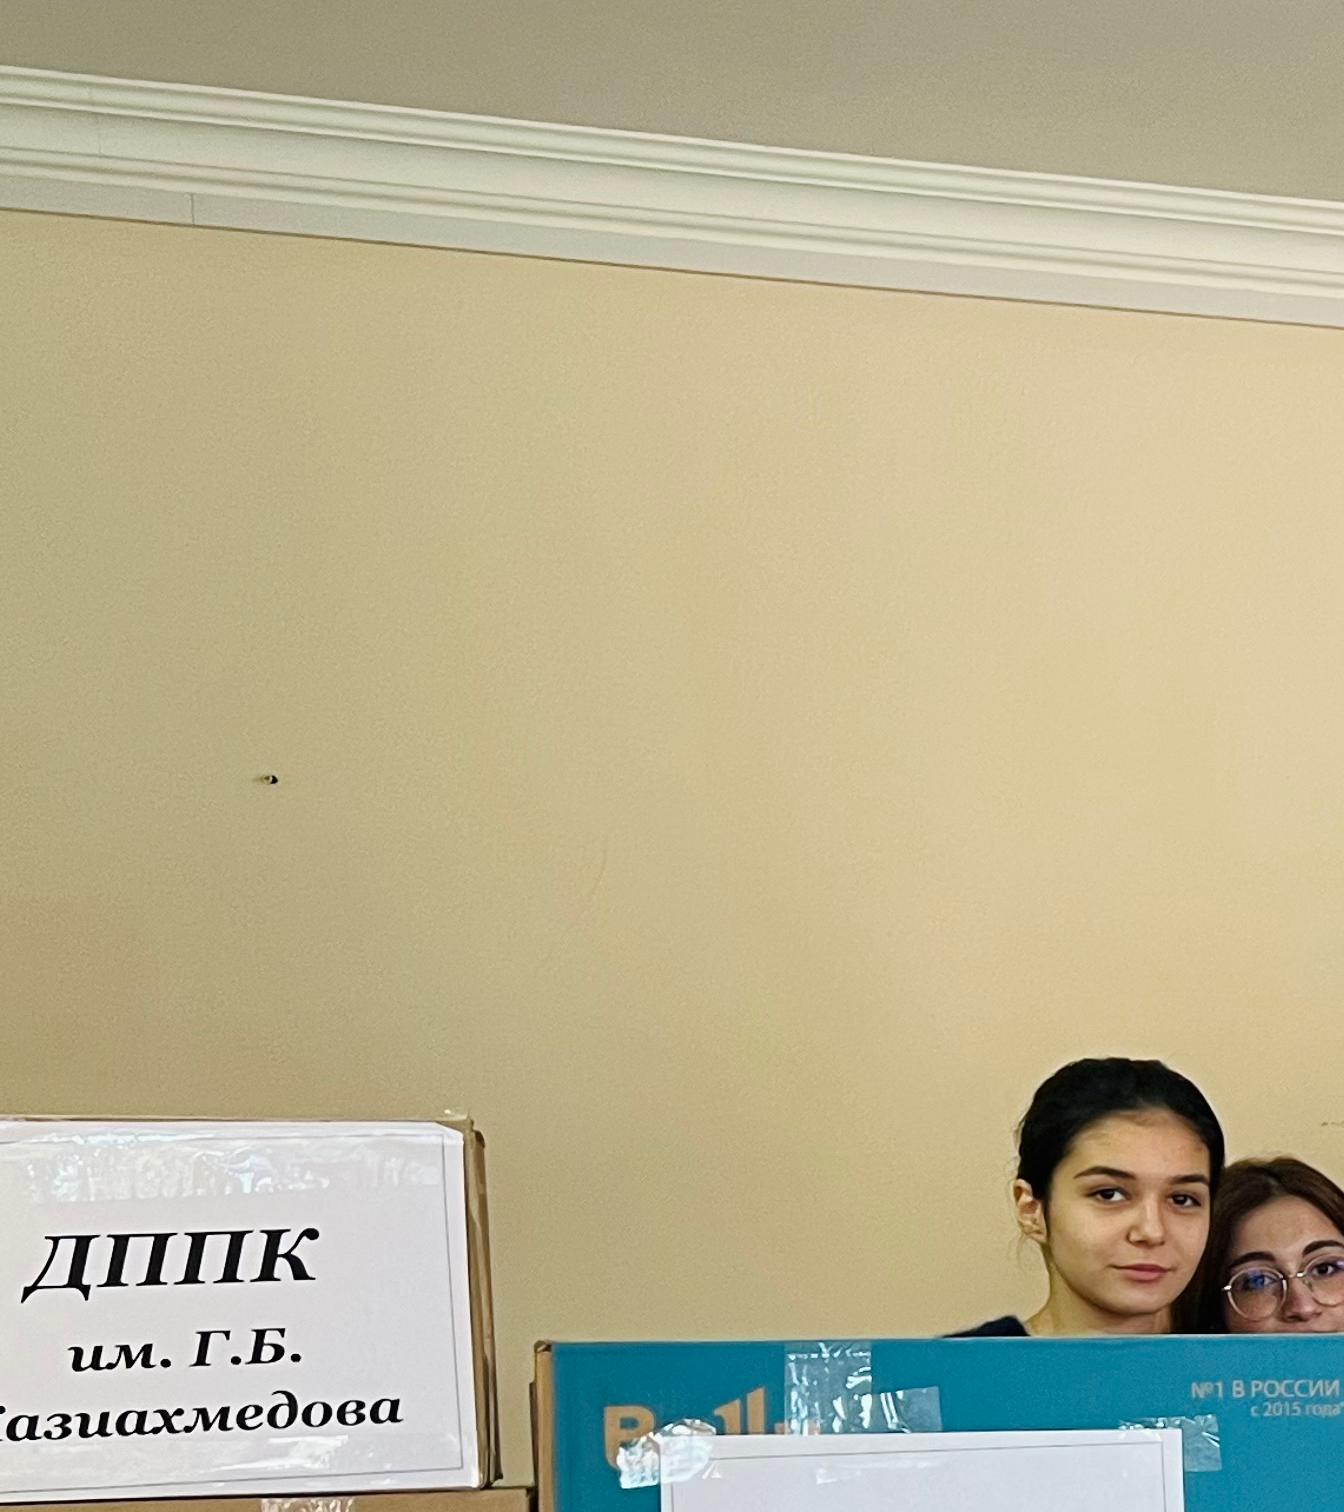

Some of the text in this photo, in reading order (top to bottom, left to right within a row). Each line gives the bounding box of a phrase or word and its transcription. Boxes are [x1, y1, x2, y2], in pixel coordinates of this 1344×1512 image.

[21, 1226, 320, 1304] ДППК
[68, 1326, 303, 1372] им. Г.Б.
[1250, 1379, 1341, 1398] РОССИИ
[1263, 1402, 1300, 1417] 2015
